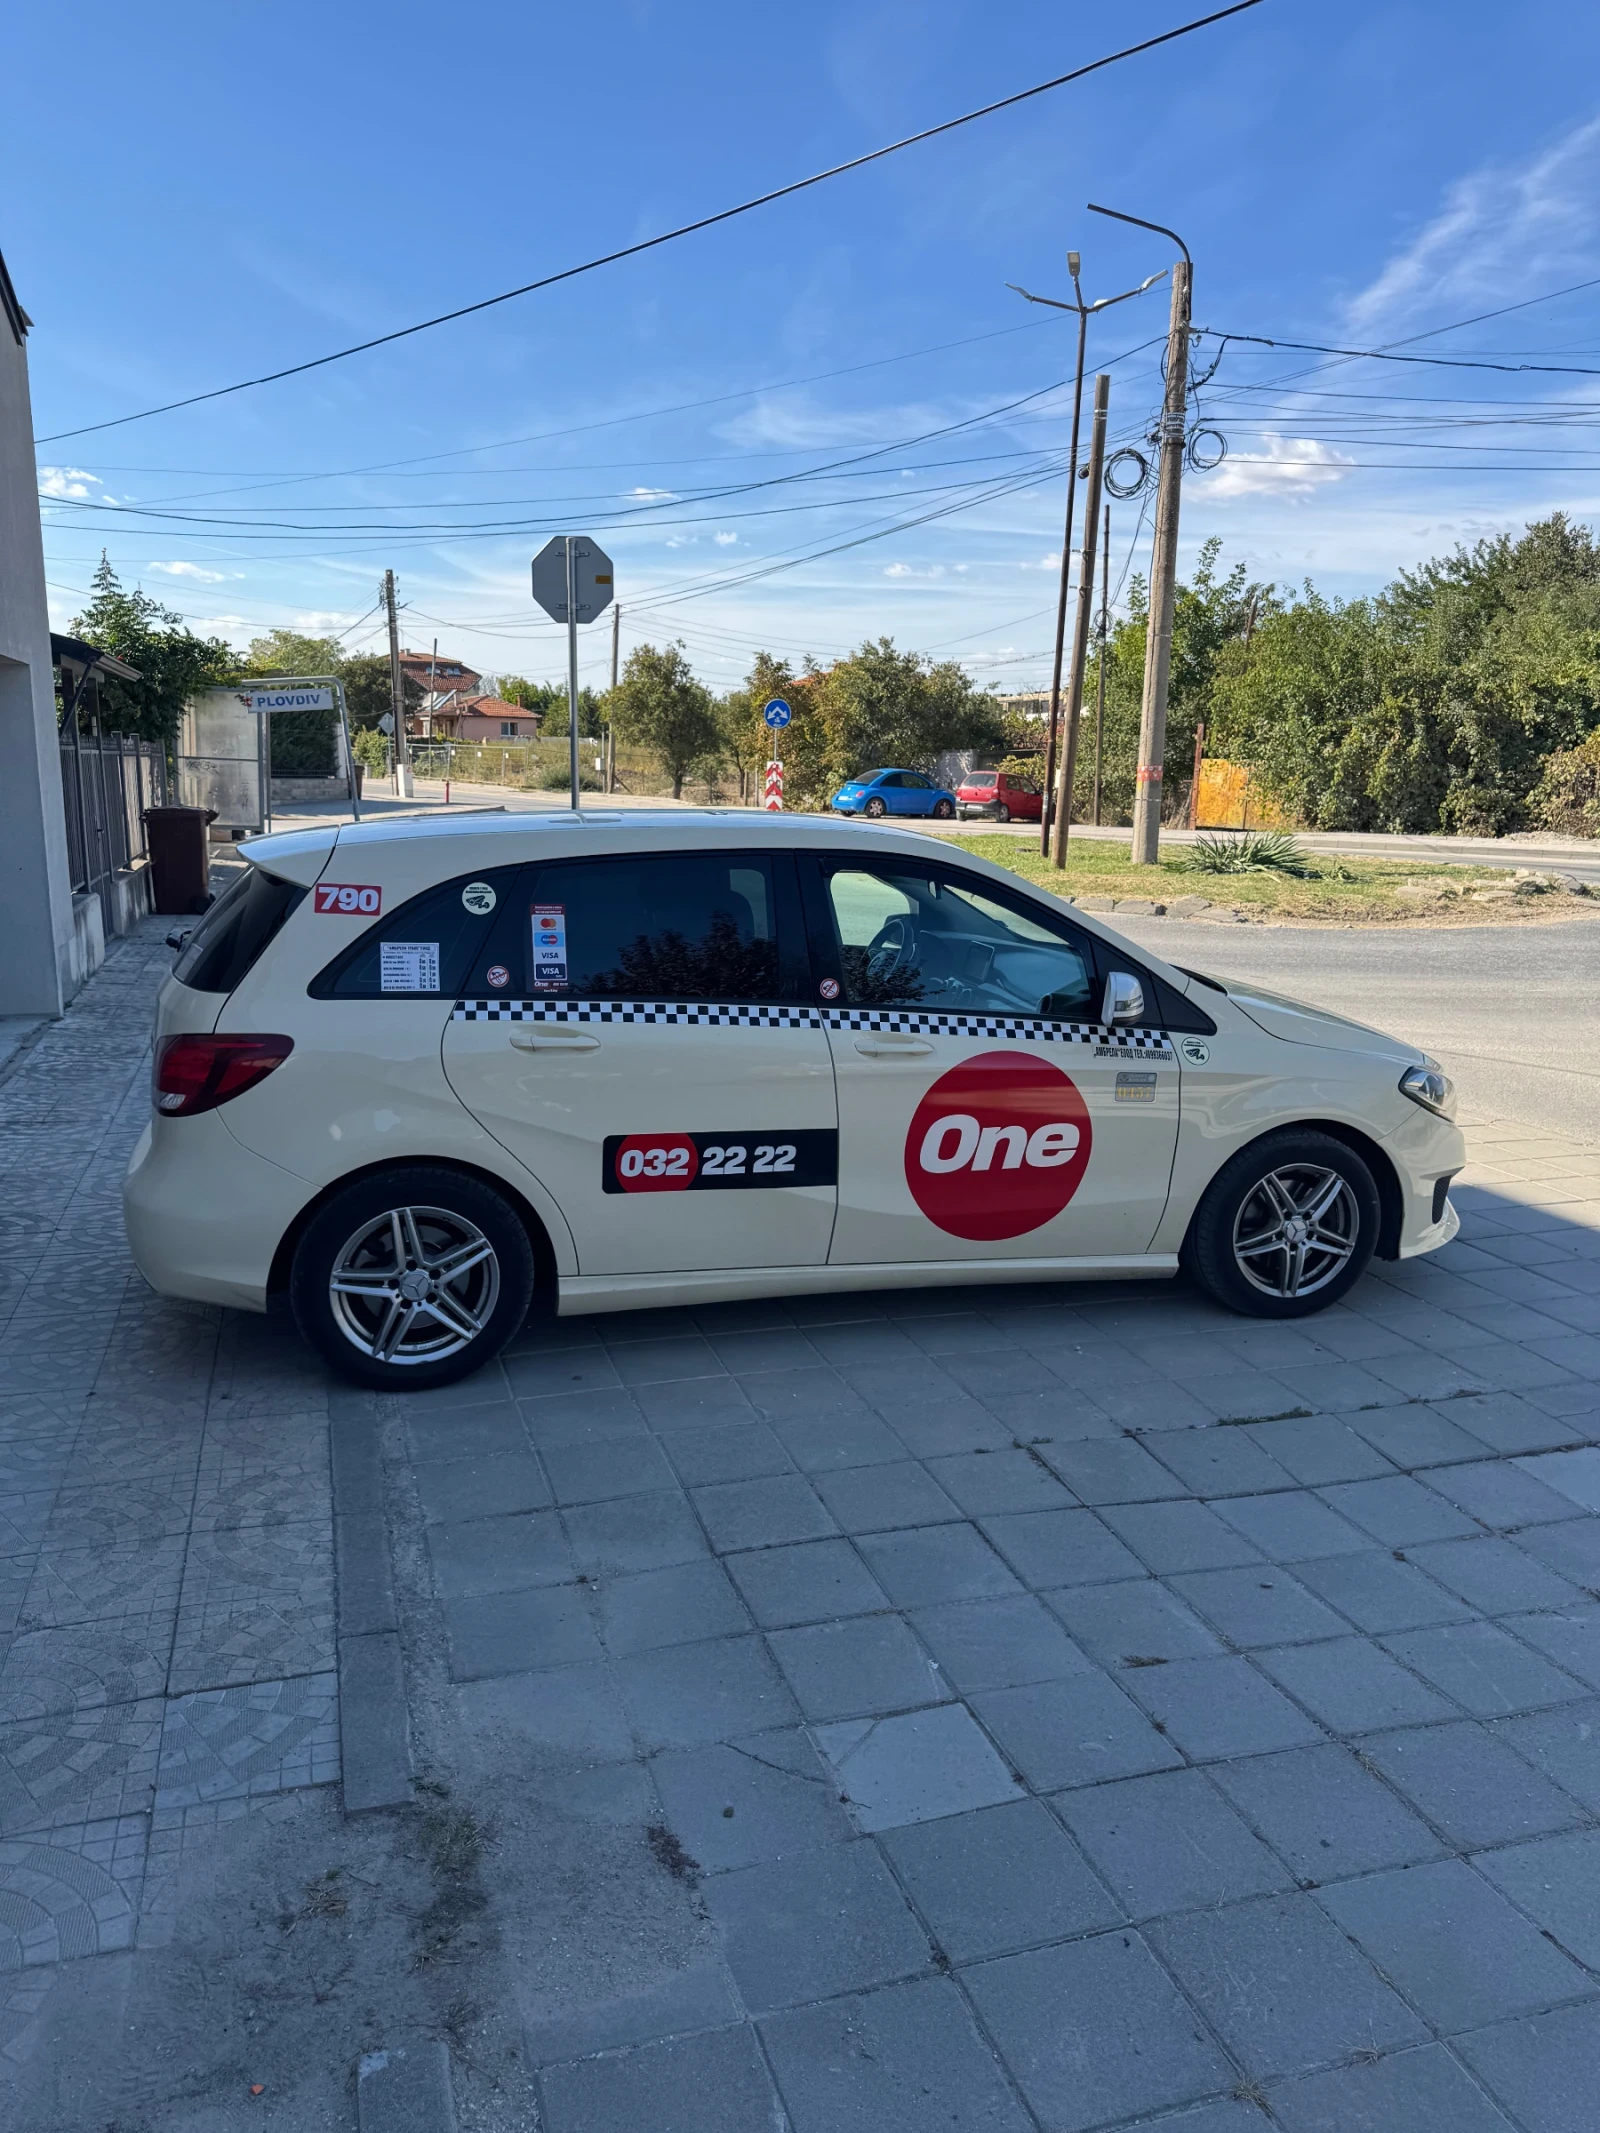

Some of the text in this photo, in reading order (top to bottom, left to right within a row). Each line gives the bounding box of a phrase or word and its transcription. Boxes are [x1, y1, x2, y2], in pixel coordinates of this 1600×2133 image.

[257, 694, 320, 707] PLOVDIV
[318, 886, 379, 912] 790
[541, 967, 560, 975] VISA
[919, 1114, 1080, 1174] One
[620, 1145, 797, 1178] 032 22 22
